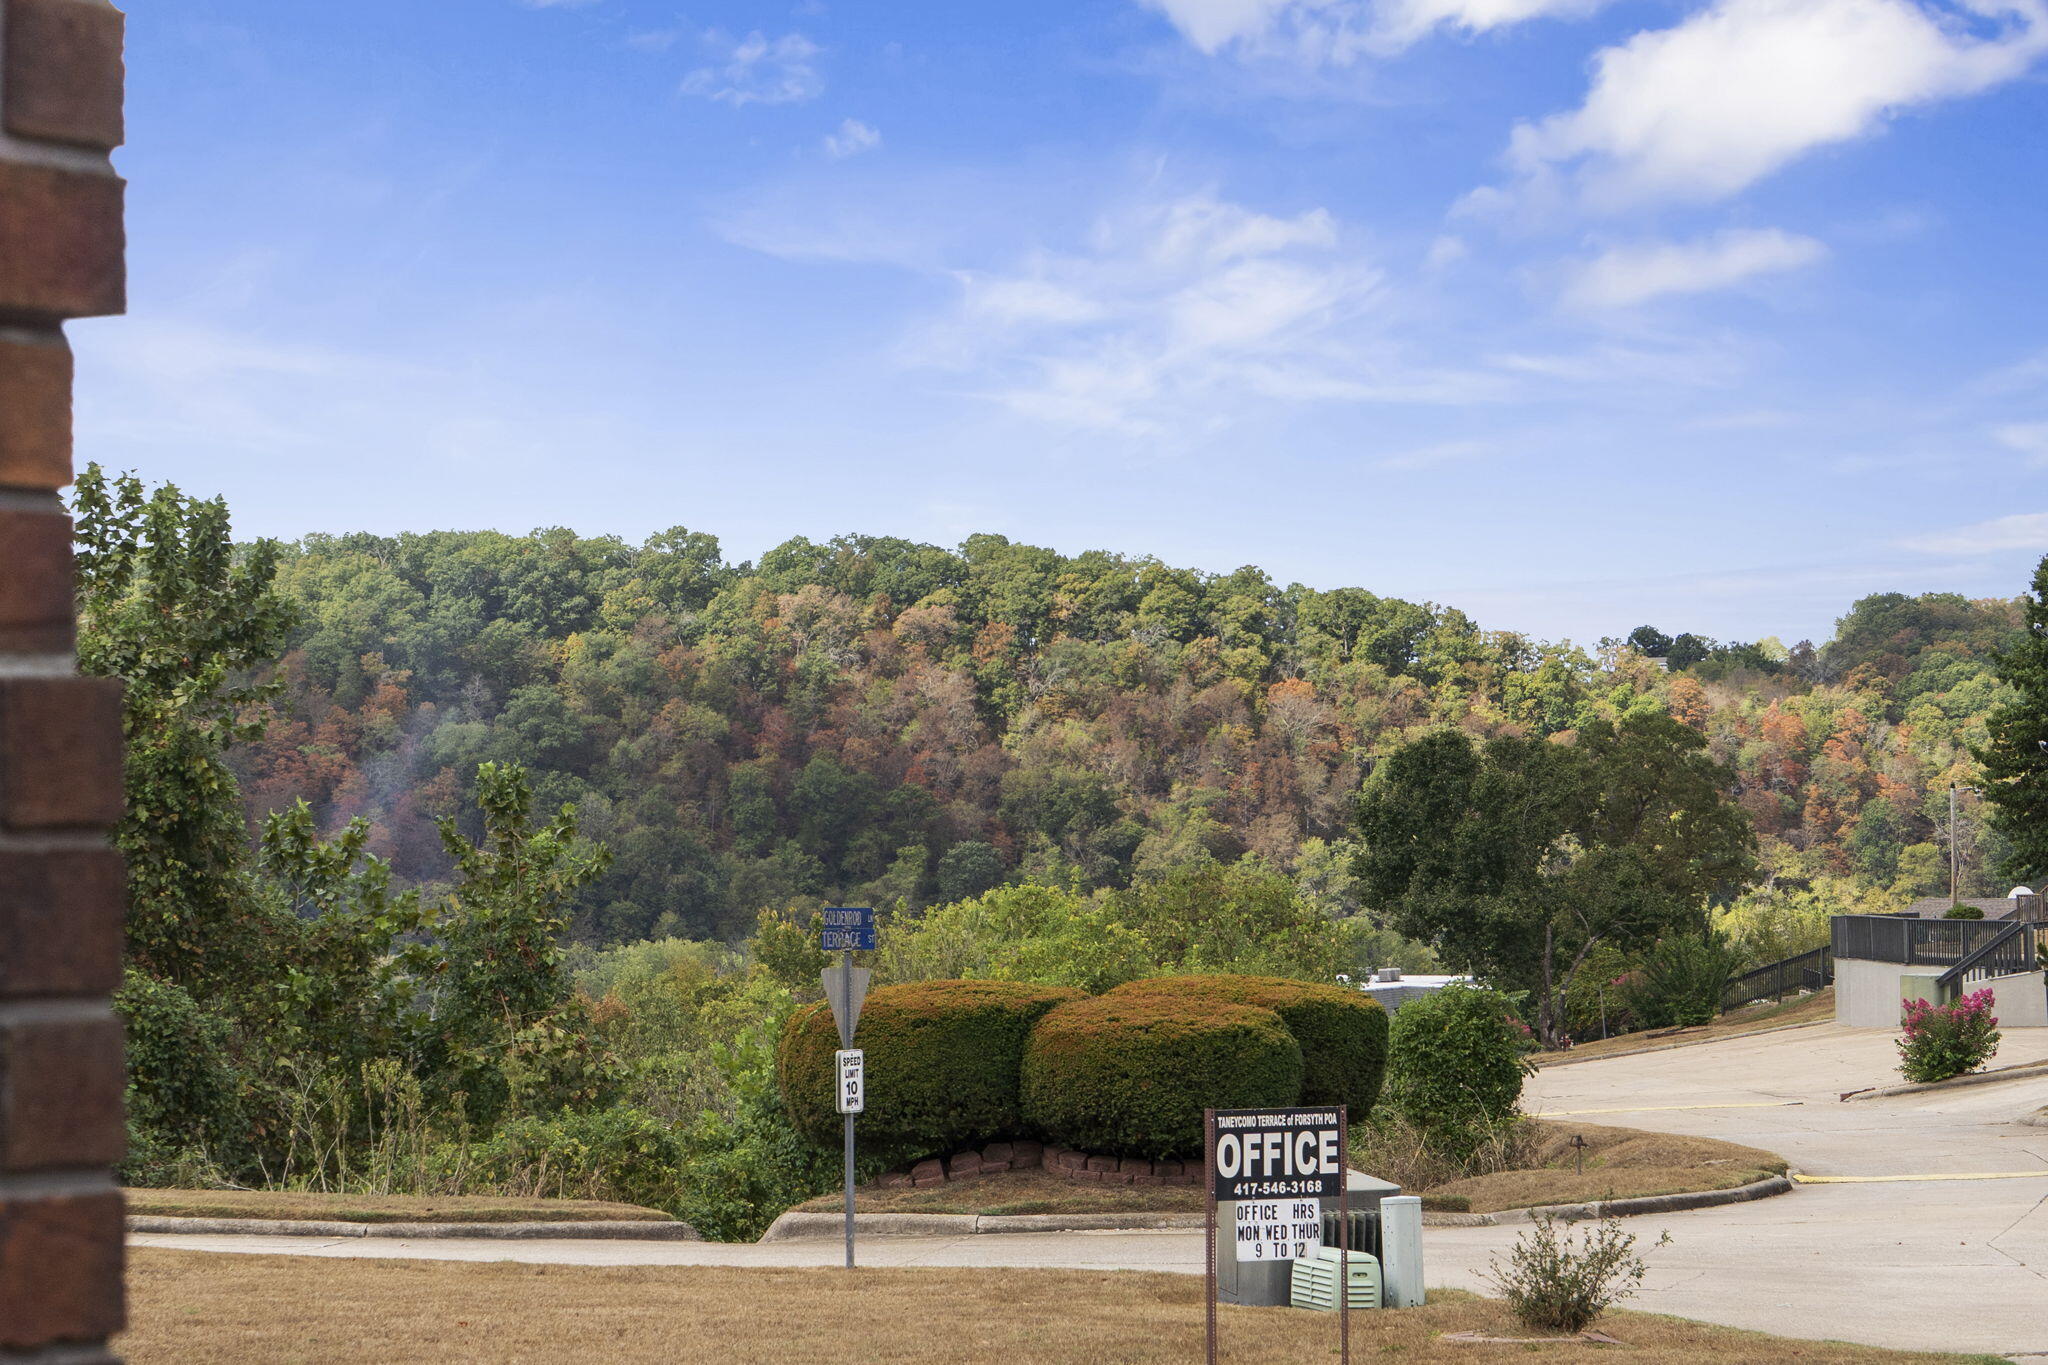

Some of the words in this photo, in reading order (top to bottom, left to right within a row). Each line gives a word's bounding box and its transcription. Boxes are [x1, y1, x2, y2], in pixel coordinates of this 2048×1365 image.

[822, 931, 861, 948] TERRACE
[867, 934, 875, 943] ST
[843, 1056, 861, 1067] SPEED
[845, 1069, 859, 1079] LIMIT
[846, 1081, 858, 1096] 10
[846, 1097, 859, 1107] MPH
[1217, 1115, 1256, 1128] TANEYCOMO
[1257, 1114, 1287, 1127] TERRACE
[1287, 1114, 1294, 1125] of
[1294, 1113, 1323, 1125] FORSYTH
[1324, 1113, 1337, 1125] POA
[1217, 1130, 1339, 1178] OFFICE
[1234, 1180, 1322, 1195] 417-546-3168
[1237, 1205, 1278, 1220] OFFICE
[1293, 1204, 1314, 1219] HRS
[1238, 1225, 1260, 1241] MON
[1266, 1224, 1287, 1240] WED
[1292, 1223, 1320, 1240] THUR
[1255, 1243, 1262, 1258] 9
[1273, 1243, 1287, 1257] TO
[1294, 1242, 1305, 1258] 12
